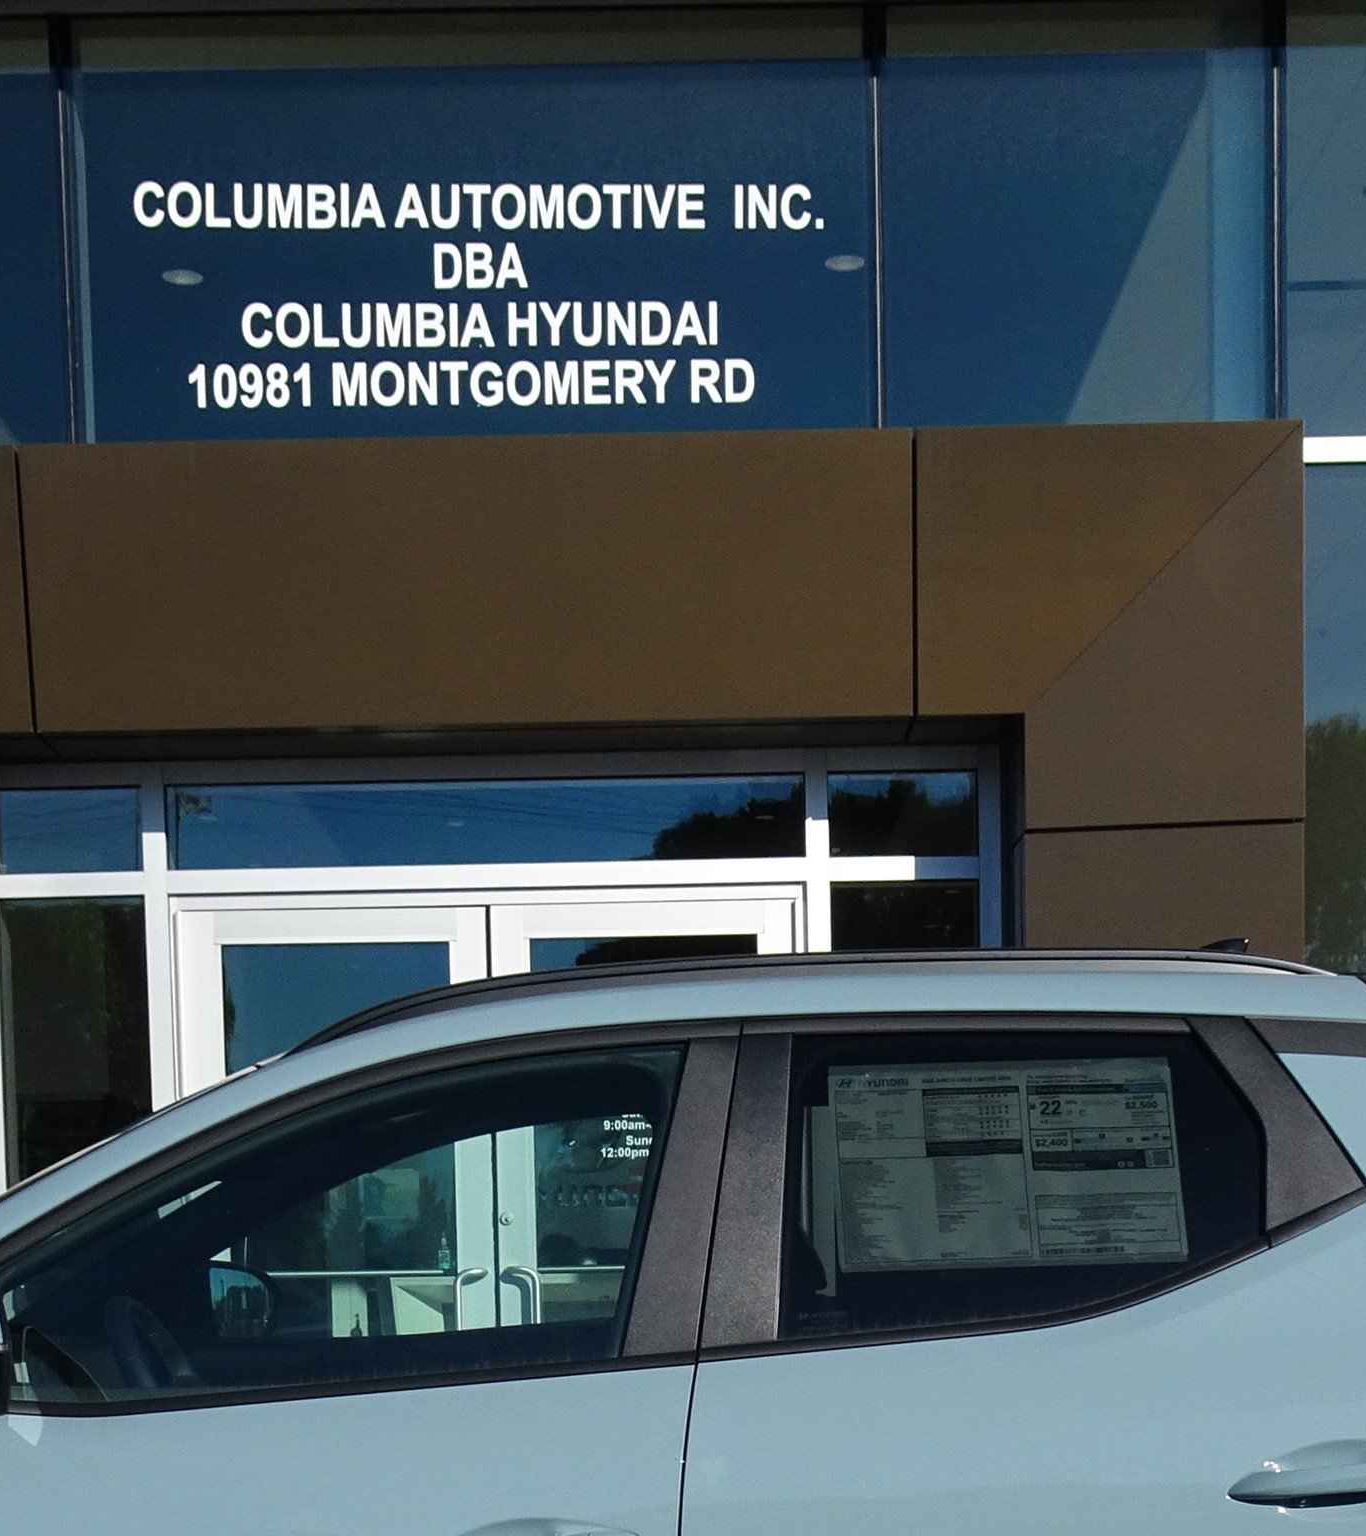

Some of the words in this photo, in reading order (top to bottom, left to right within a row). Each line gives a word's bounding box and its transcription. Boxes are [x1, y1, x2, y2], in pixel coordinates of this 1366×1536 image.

[134, 182, 385, 228] COLUMBIA
[395, 184, 705, 229] AUTOMOTIVE
[735, 184, 824, 229] INC.
[434, 243, 528, 289] DBA
[242, 303, 495, 348] COLUMBIA
[508, 301, 717, 346] HYUNDAI
[189, 363, 311, 408] 10981
[332, 360, 676, 406] MONTGOMERY
[691, 359, 754, 403] RD
[858, 1077, 909, 1088] YUNDAI
[1039, 1100, 1062, 1116] 22
[1124, 1100, 1158, 1110] $2,500
[1034, 1137, 1068, 1148] $2,400
